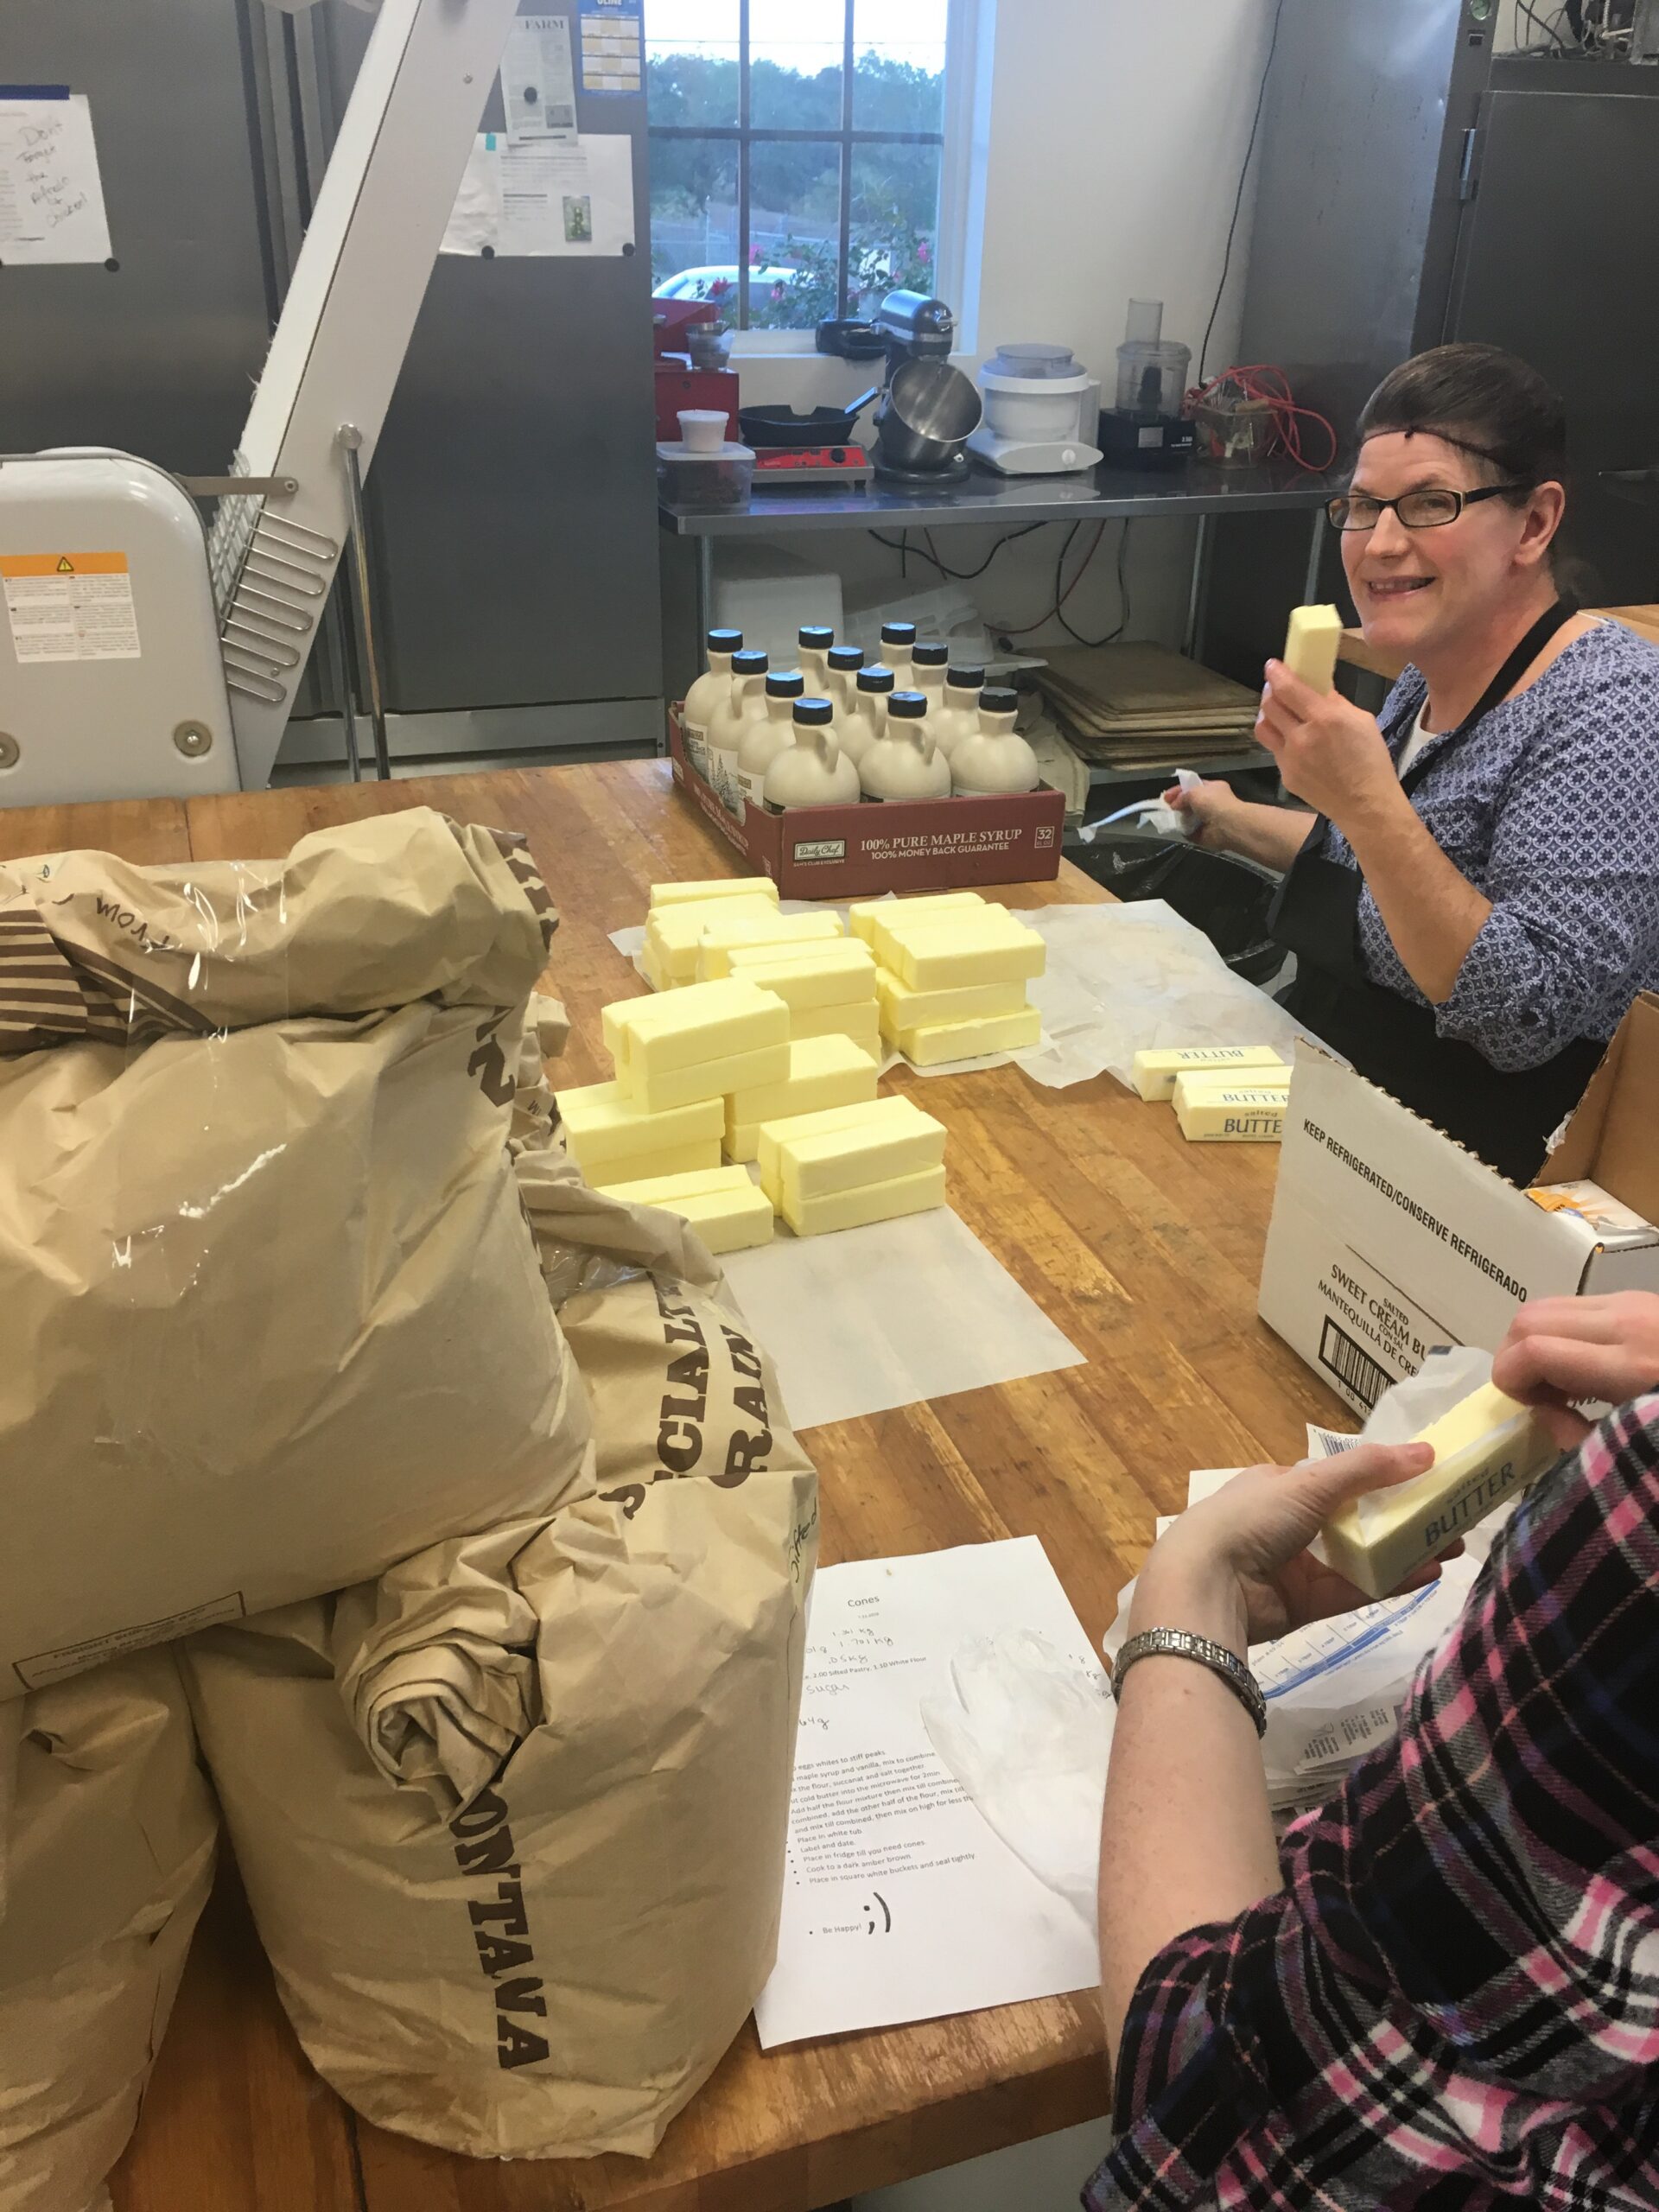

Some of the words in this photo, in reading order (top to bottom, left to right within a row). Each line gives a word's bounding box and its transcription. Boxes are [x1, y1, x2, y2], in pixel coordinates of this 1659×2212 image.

[861, 839, 890, 851] 100%
[893, 836, 928, 849] PURE
[931, 832, 977, 847] MAPLE
[979, 829, 1022, 842] SYRUP
[1037, 829, 1052, 840] 32
[799, 845, 821, 856] Daily
[821, 843, 841, 855] Chef
[871, 850, 897, 860] 100%
[899, 848, 931, 858] MONEY
[932, 845, 957, 855] BACK
[957, 842, 1009, 853] GUARANTEE
[1178, 1050, 1244, 1059] BUTTER
[1224, 1118, 1282, 1134] BUTTE
[1303, 1118, 1326, 1143] KEEP
[1326, 1136, 1450, 1243] REFRIGERATED/CONSERVE
[1450, 1233, 1528, 1303] REFRIGERADO
[1332, 1264, 1368, 1305] SWEET
[1369, 1299, 1410, 1345] CREAM
[1382, 1298, 1409, 1325] SALTED
[1318, 1280, 1382, 1348] MANTEQUILLA
[1382, 1342, 1396, 1360] DE
[1398, 1354, 1419, 1377] CRE
[1379, 1324, 1393, 1338] CON
[1392, 1336, 1404, 1351] SAL
[1425, 1462, 1516, 1548] BUTTER
[848, 1596, 880, 1607] Cones
[829, 1669, 849, 1677] Sifted
[888, 1659, 909, 1668] White
[849, 1753, 863, 1762] stiff
[820, 1770, 840, 1778] syrup
[855, 1762, 881, 1771] vanilla,
[799, 1795, 816, 1803] cold
[817, 1791, 839, 1800] butter
[870, 1777, 909, 1789] microwave
[855, 1793, 883, 1802] mixture
[884, 1788, 901, 1796] then
[836, 1815, 874, 1826] combined,
[874, 1810, 893, 1820] then
[918, 1802, 936, 1811] high
[948, 1796, 963, 1805] less
[860, 1803, 880, 1812] other
[881, 1798, 895, 1807] half
[800, 1844, 821, 1853] Label
[883, 1842, 902, 1852] need
[805, 1865, 825, 1873] Cook
[861, 1859, 886, 1867] amber
[839, 1872, 865, 1881] square
[866, 1870, 888, 1878] white
[889, 1865, 919, 1874] buckets
[919, 1860, 934, 1869] and
[935, 1857, 950, 1866] seal
[951, 1852, 975, 1863] tightly
[822, 1926, 833, 1935] Be
[835, 1923, 862, 1936] Happy!
